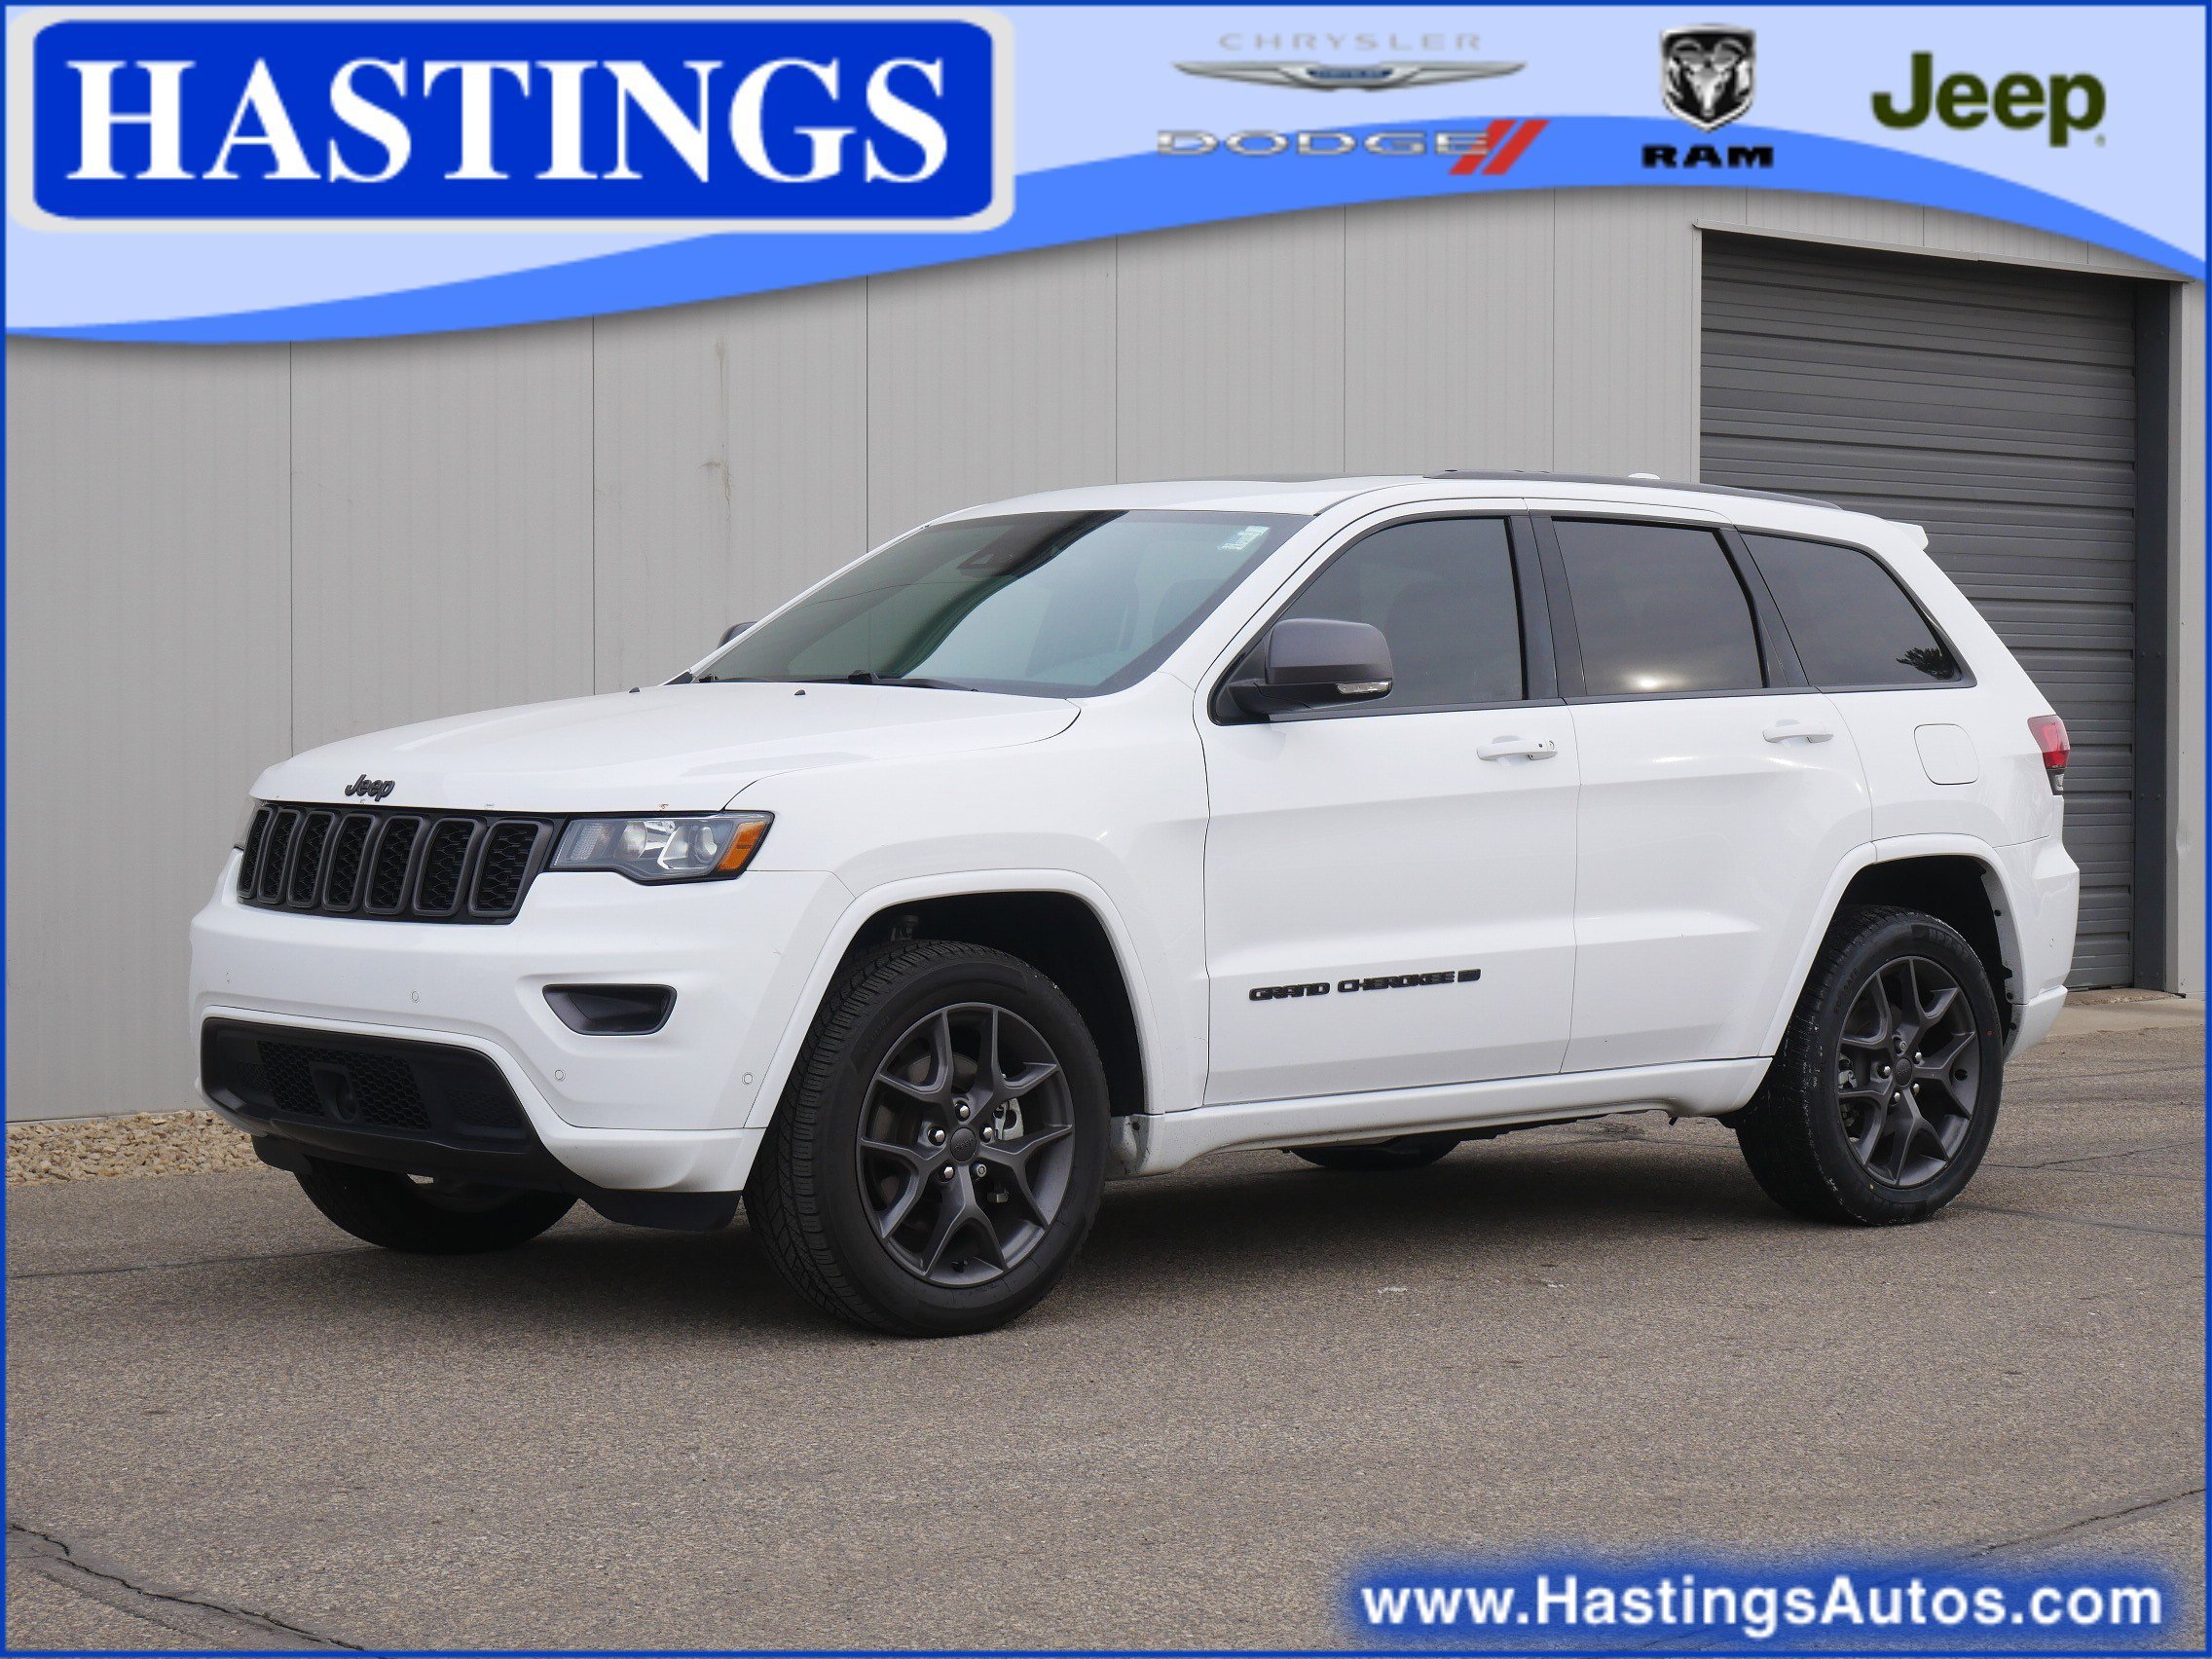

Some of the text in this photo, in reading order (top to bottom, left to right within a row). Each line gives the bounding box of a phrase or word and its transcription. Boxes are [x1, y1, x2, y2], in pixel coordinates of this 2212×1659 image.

[345, 774, 395, 802] Jeep
[1249, 982, 1331, 1001] GRAND
[1337, 971, 1456, 993] CHEROKEE
